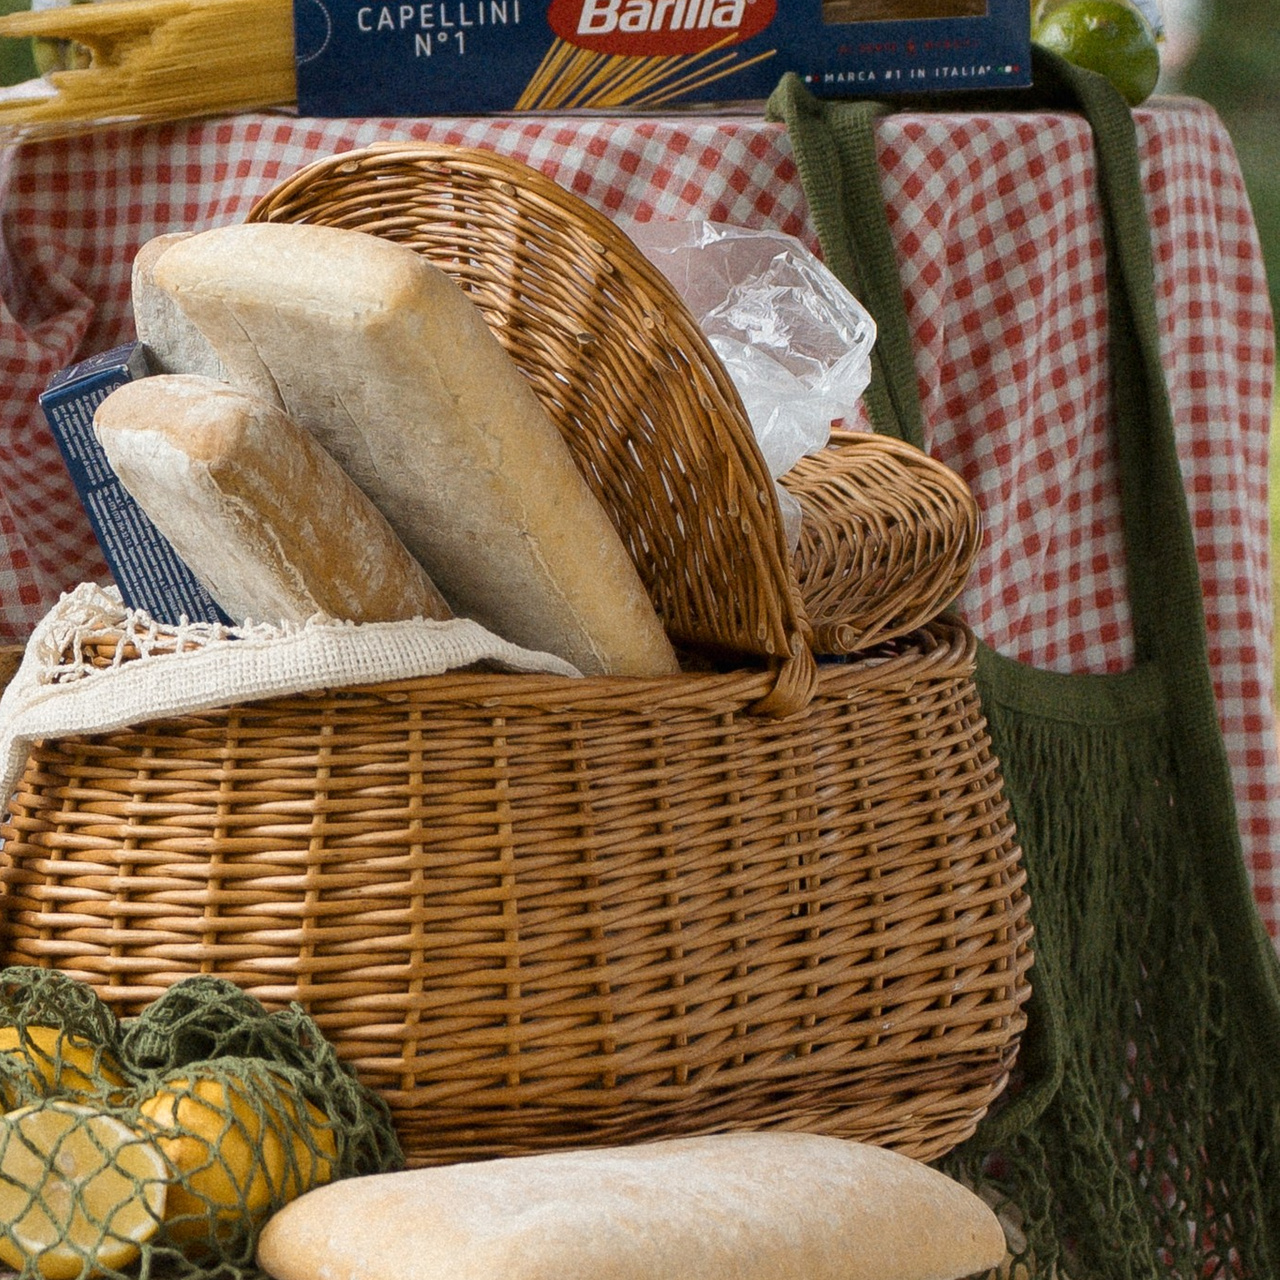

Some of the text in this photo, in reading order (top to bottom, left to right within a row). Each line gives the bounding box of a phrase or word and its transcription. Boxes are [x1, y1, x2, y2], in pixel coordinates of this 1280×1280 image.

[357, 0, 520, 32] CAPELLINI
[414, 31, 465, 58] N°1
[824, 70, 876, 83] MARCA
[884, 69, 901, 80] #1
[910, 69, 926, 79] IN
[193, 577, 212, 607] вердых
